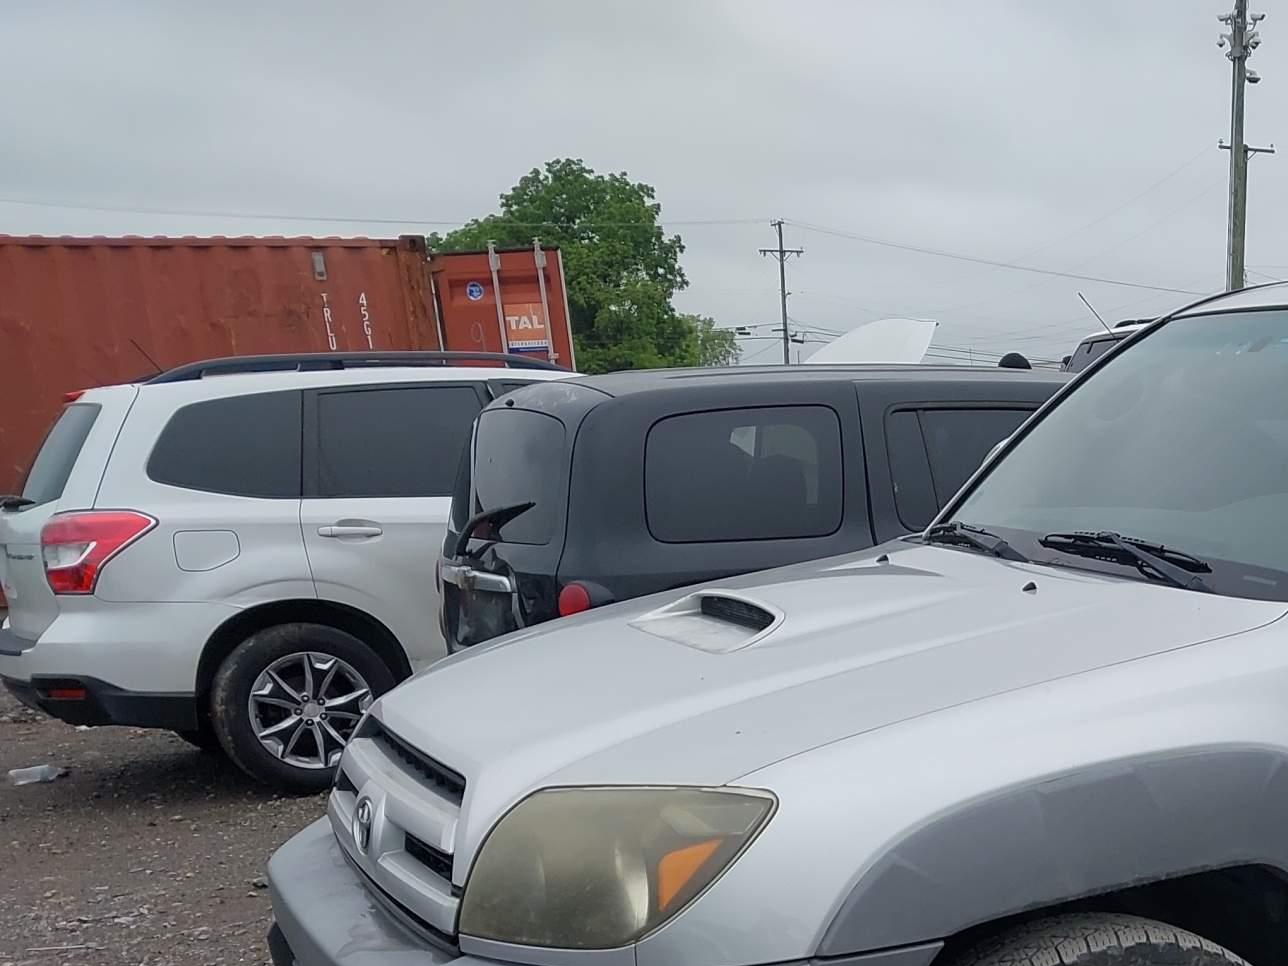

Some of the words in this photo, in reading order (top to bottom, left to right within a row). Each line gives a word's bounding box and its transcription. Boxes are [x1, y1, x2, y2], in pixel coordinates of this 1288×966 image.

[320, 292, 337, 351] TRLU
[359, 291, 373, 350] 45G1
[505, 315, 545, 330] TAL
